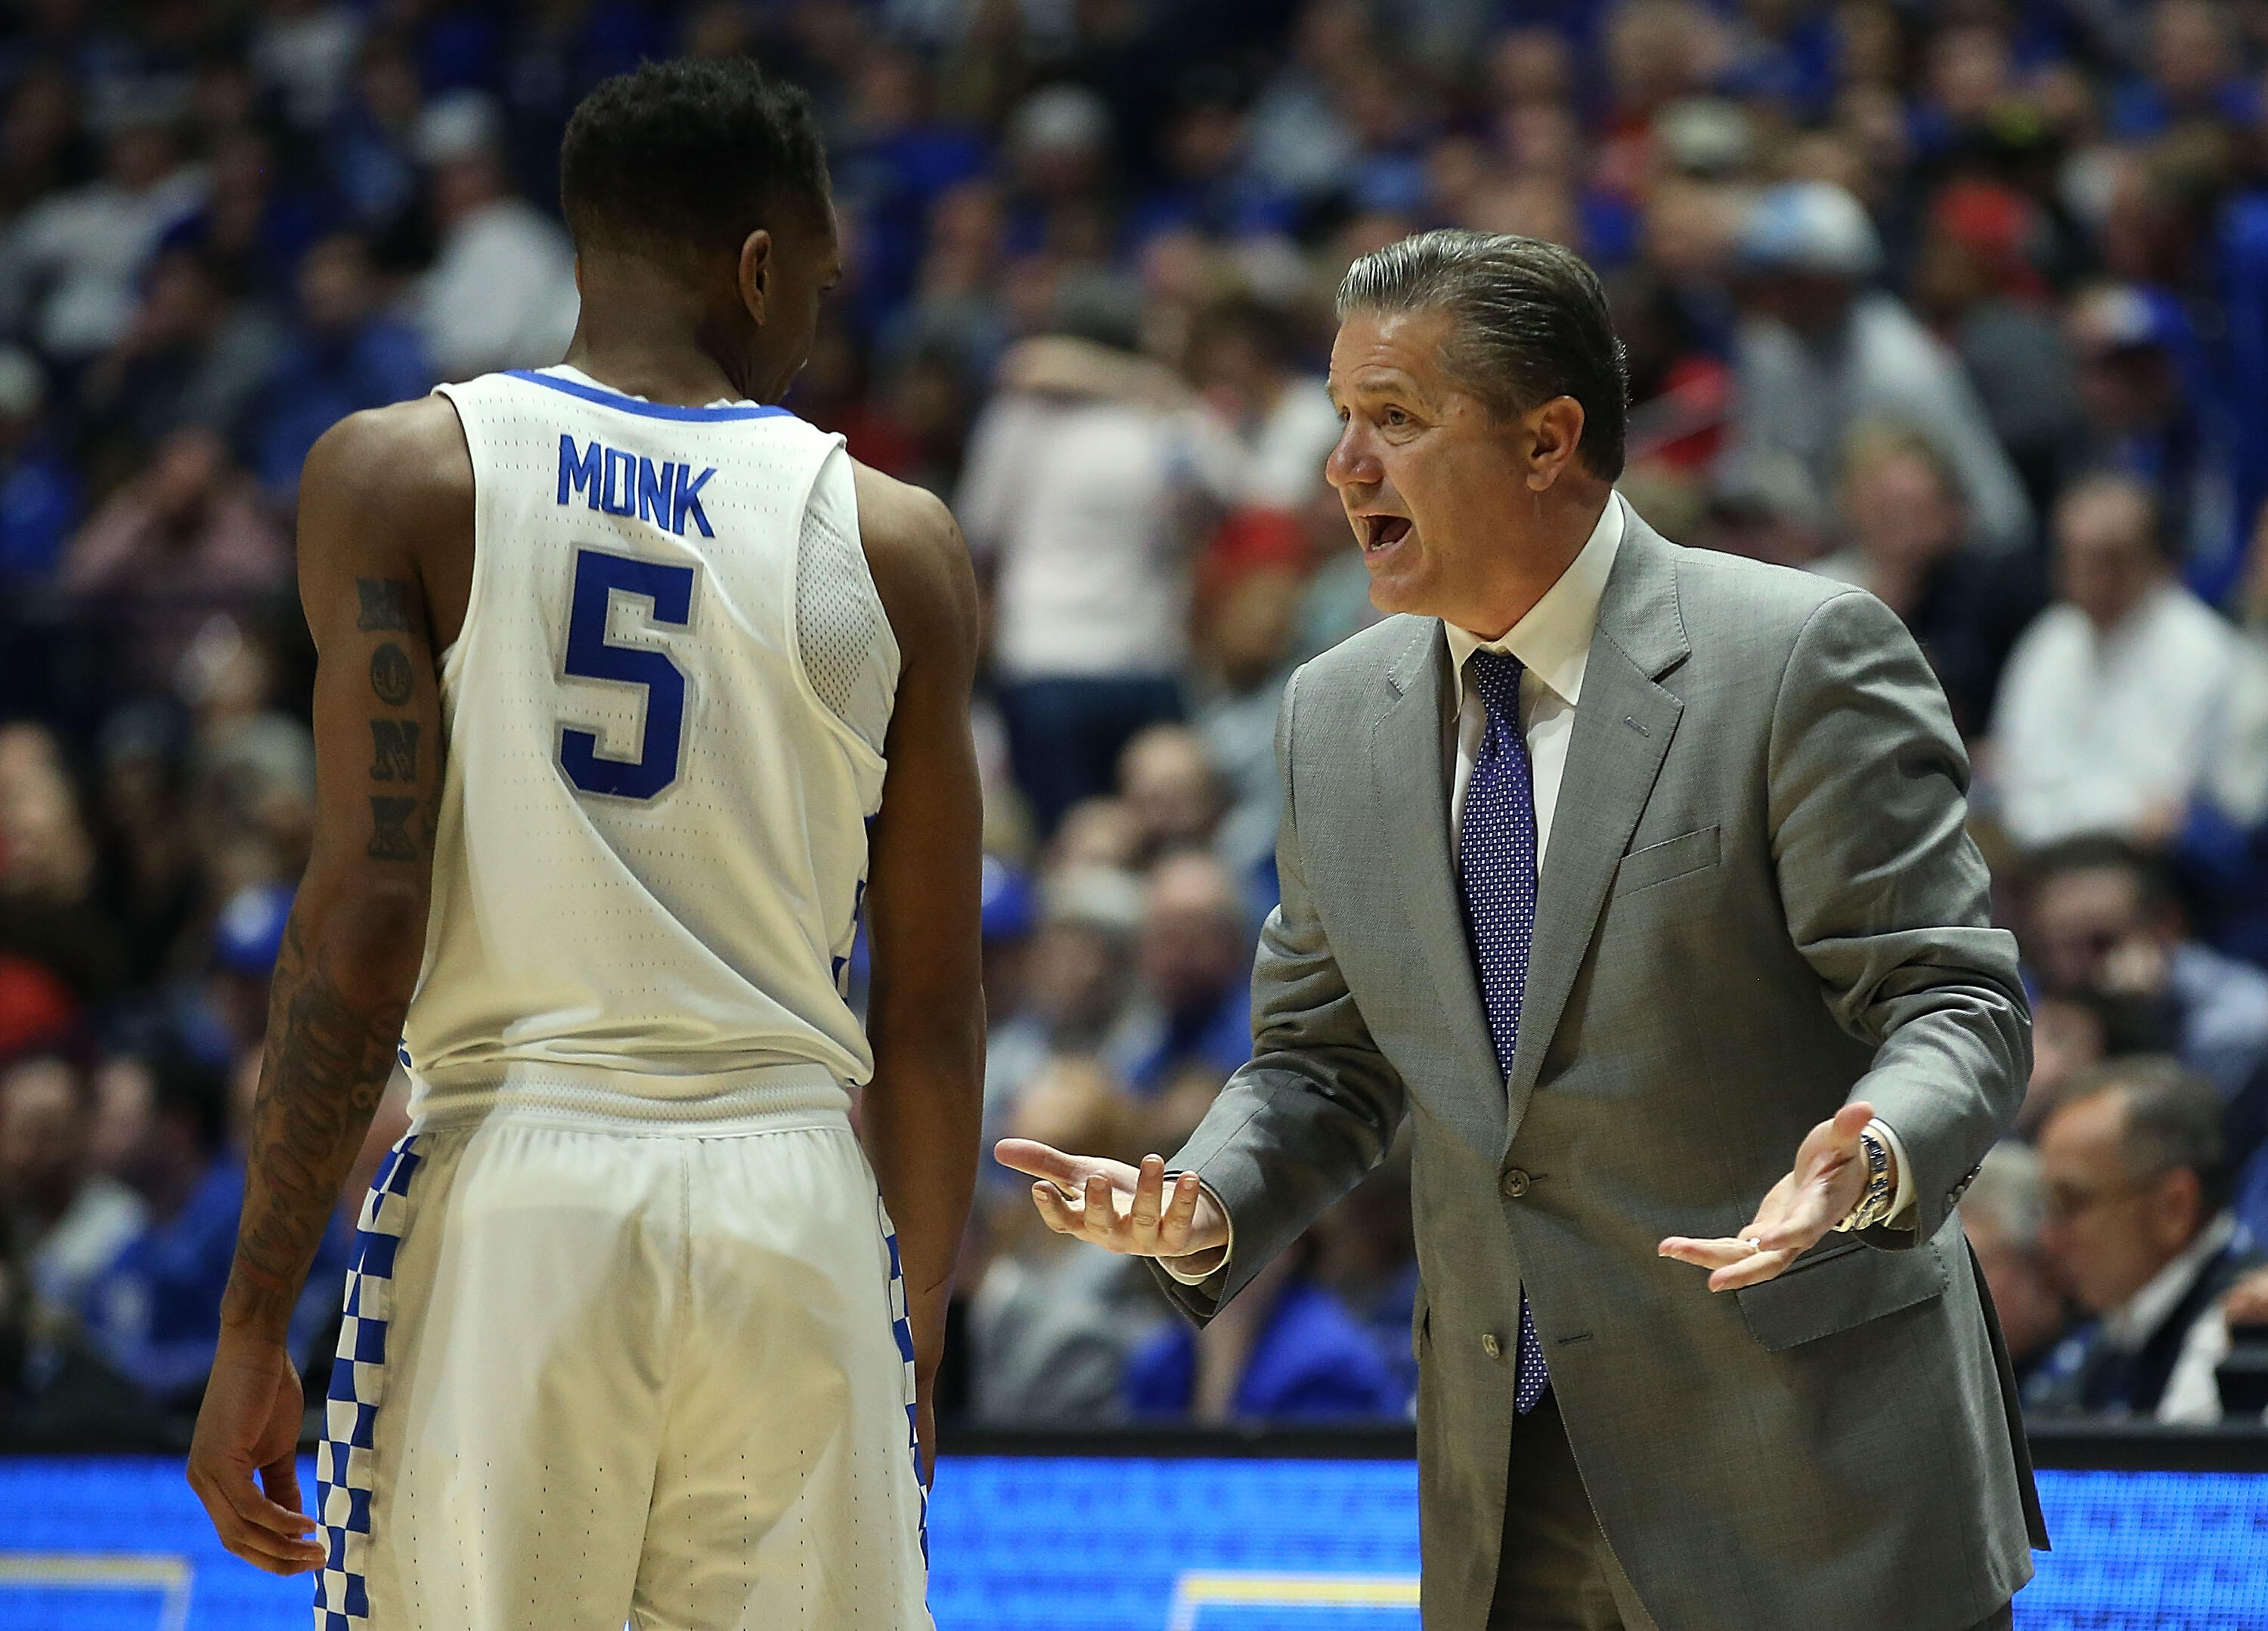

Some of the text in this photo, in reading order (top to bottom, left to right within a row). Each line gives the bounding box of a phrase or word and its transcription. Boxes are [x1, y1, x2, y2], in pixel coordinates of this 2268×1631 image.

[557, 434, 717, 538] MONK
[355, 577, 420, 861] MONK
[553, 542, 703, 808] 5
